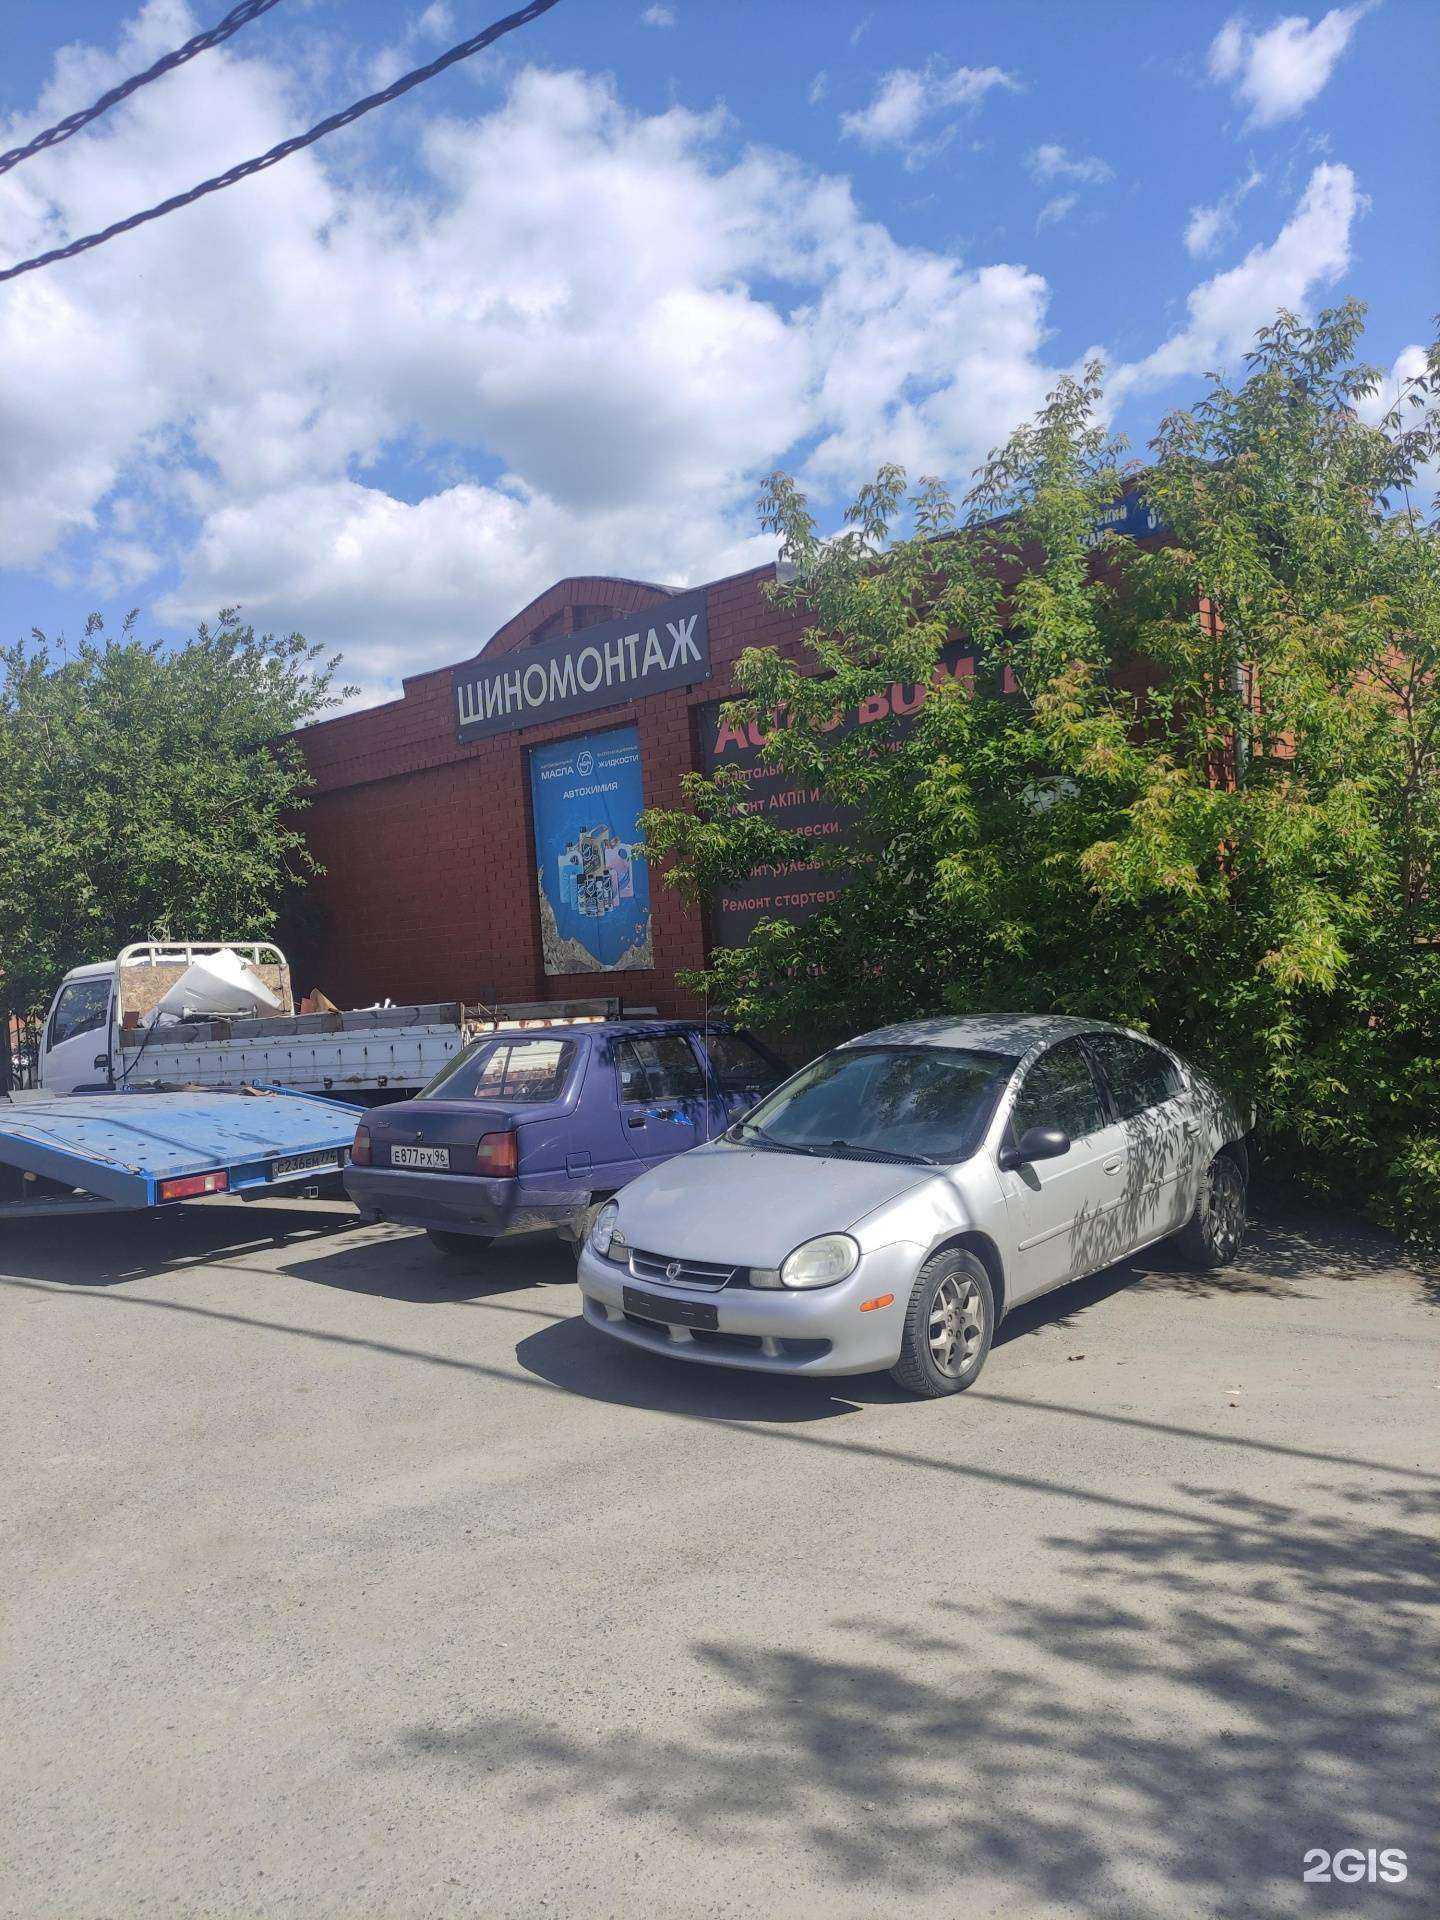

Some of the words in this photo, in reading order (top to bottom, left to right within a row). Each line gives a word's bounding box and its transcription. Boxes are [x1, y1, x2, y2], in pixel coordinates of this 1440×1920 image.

[457, 614, 702, 726] ШИНОМОНТАЖ
[598, 754, 639, 769] ЖИДКОСТИ
[541, 766, 575, 780] МАСЛА
[562, 781, 618, 799] АВТОХИМИЯ
[769, 791, 806, 809] АКПП
[722, 897, 771, 912] Ремонт
